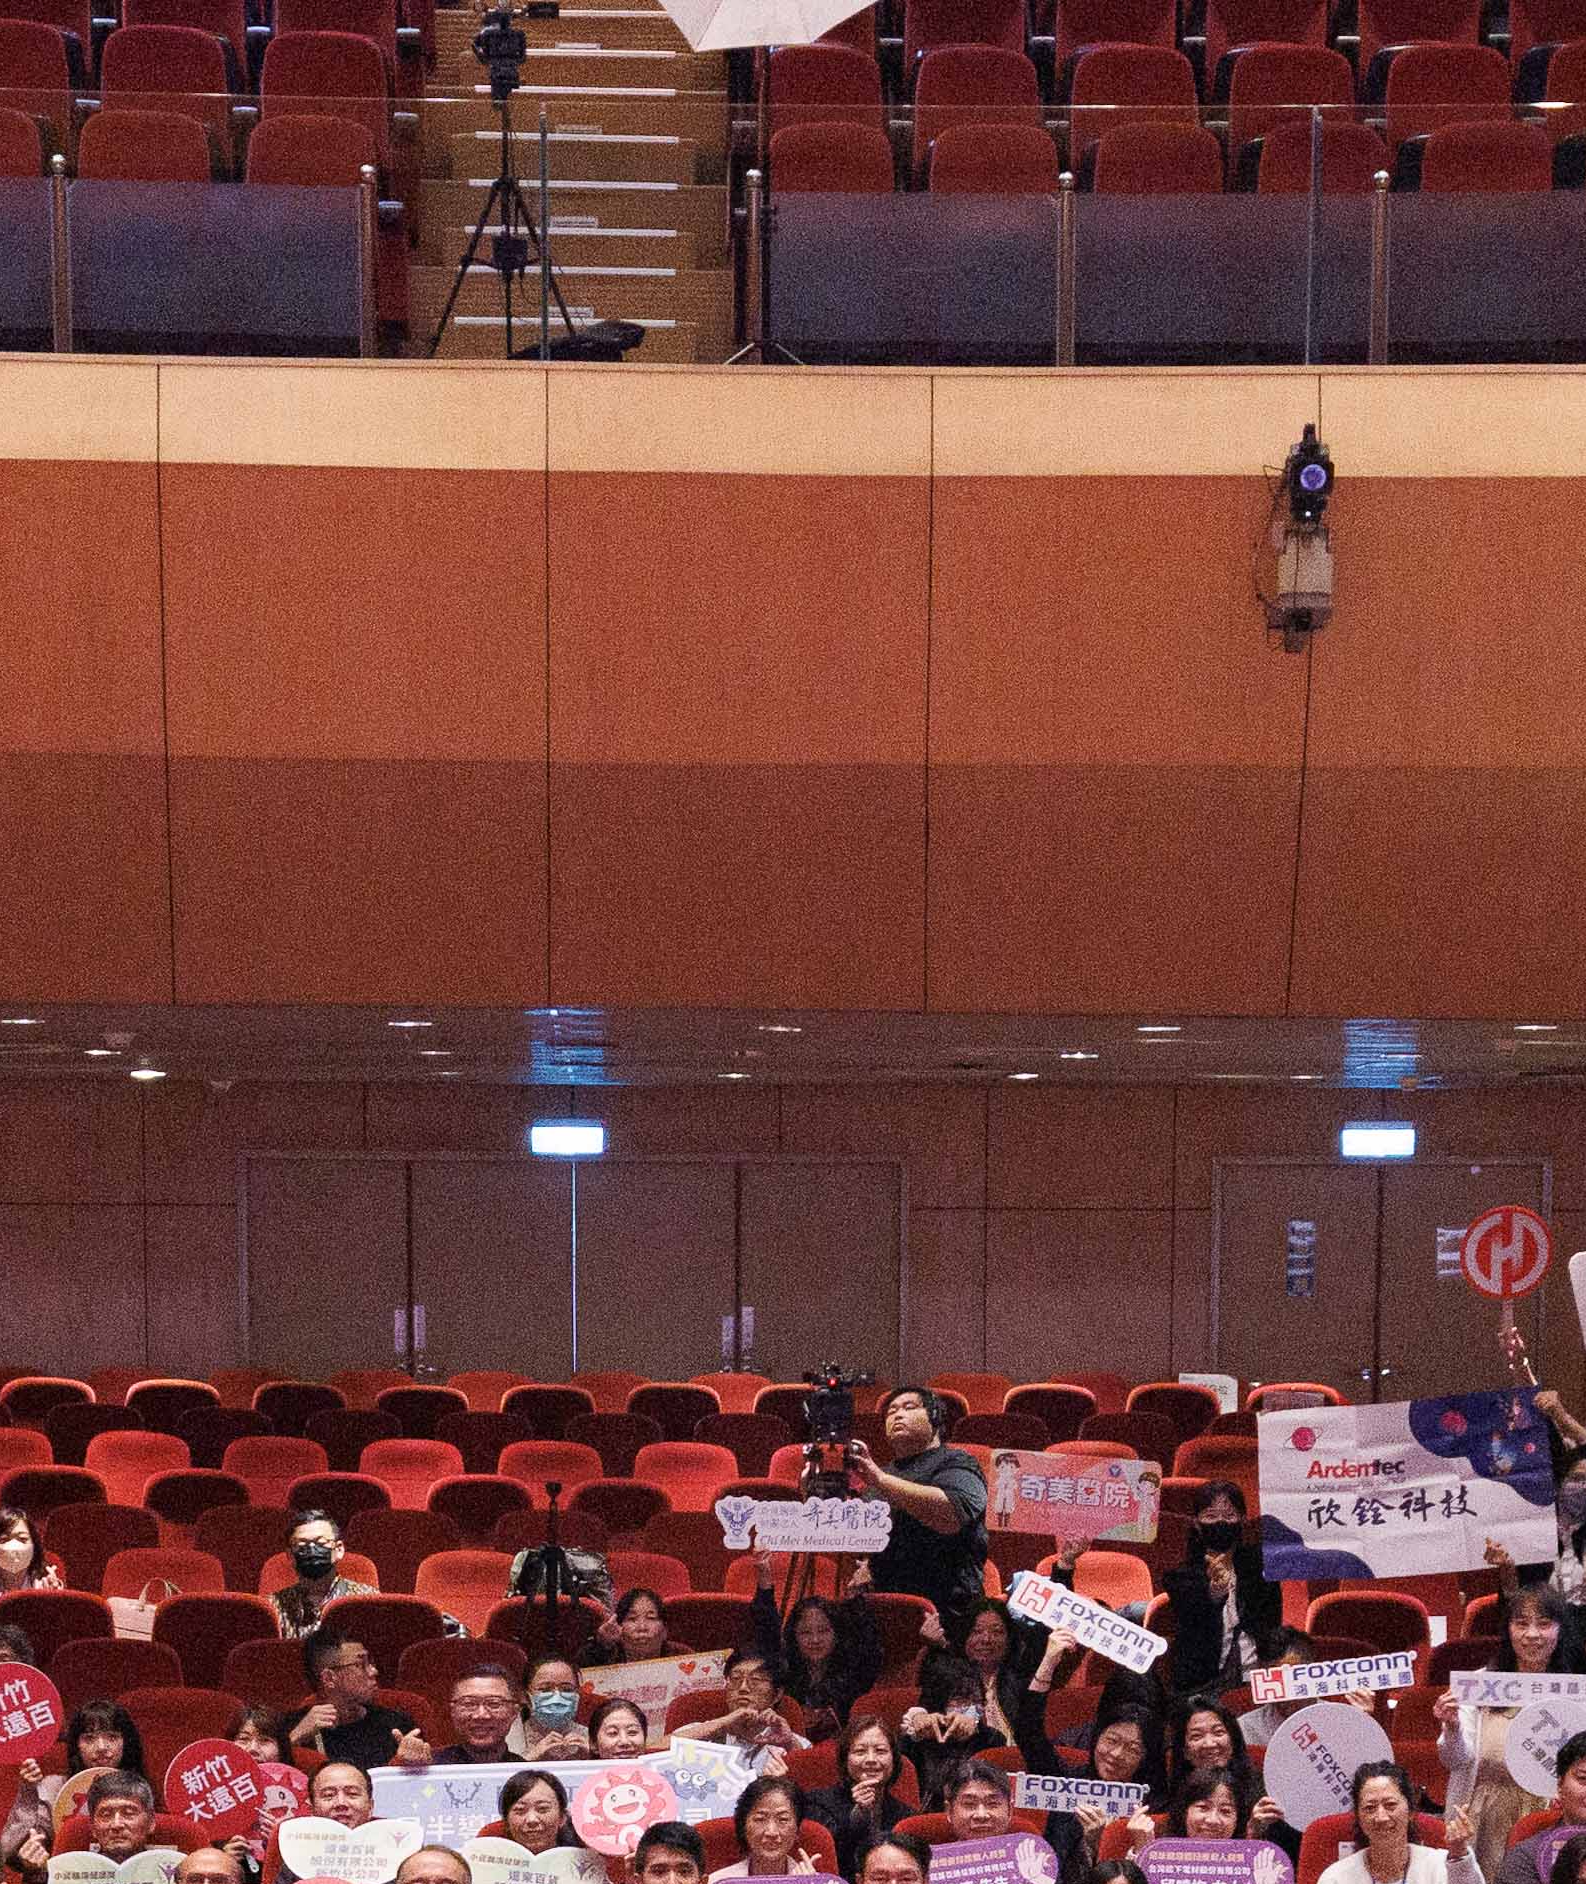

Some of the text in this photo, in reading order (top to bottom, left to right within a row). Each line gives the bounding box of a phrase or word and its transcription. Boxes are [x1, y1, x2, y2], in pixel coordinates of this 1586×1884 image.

[1308, 1457, 1405, 1479] Ardentec
[1020, 1477, 1130, 1507] 奇美醫院
[1308, 1485, 1478, 1529] 欣銓科技
[1456, 1677, 1523, 1701] TXC
[180, 1758, 233, 1796] 新竹
[185, 1778, 259, 1821] 大遠百
